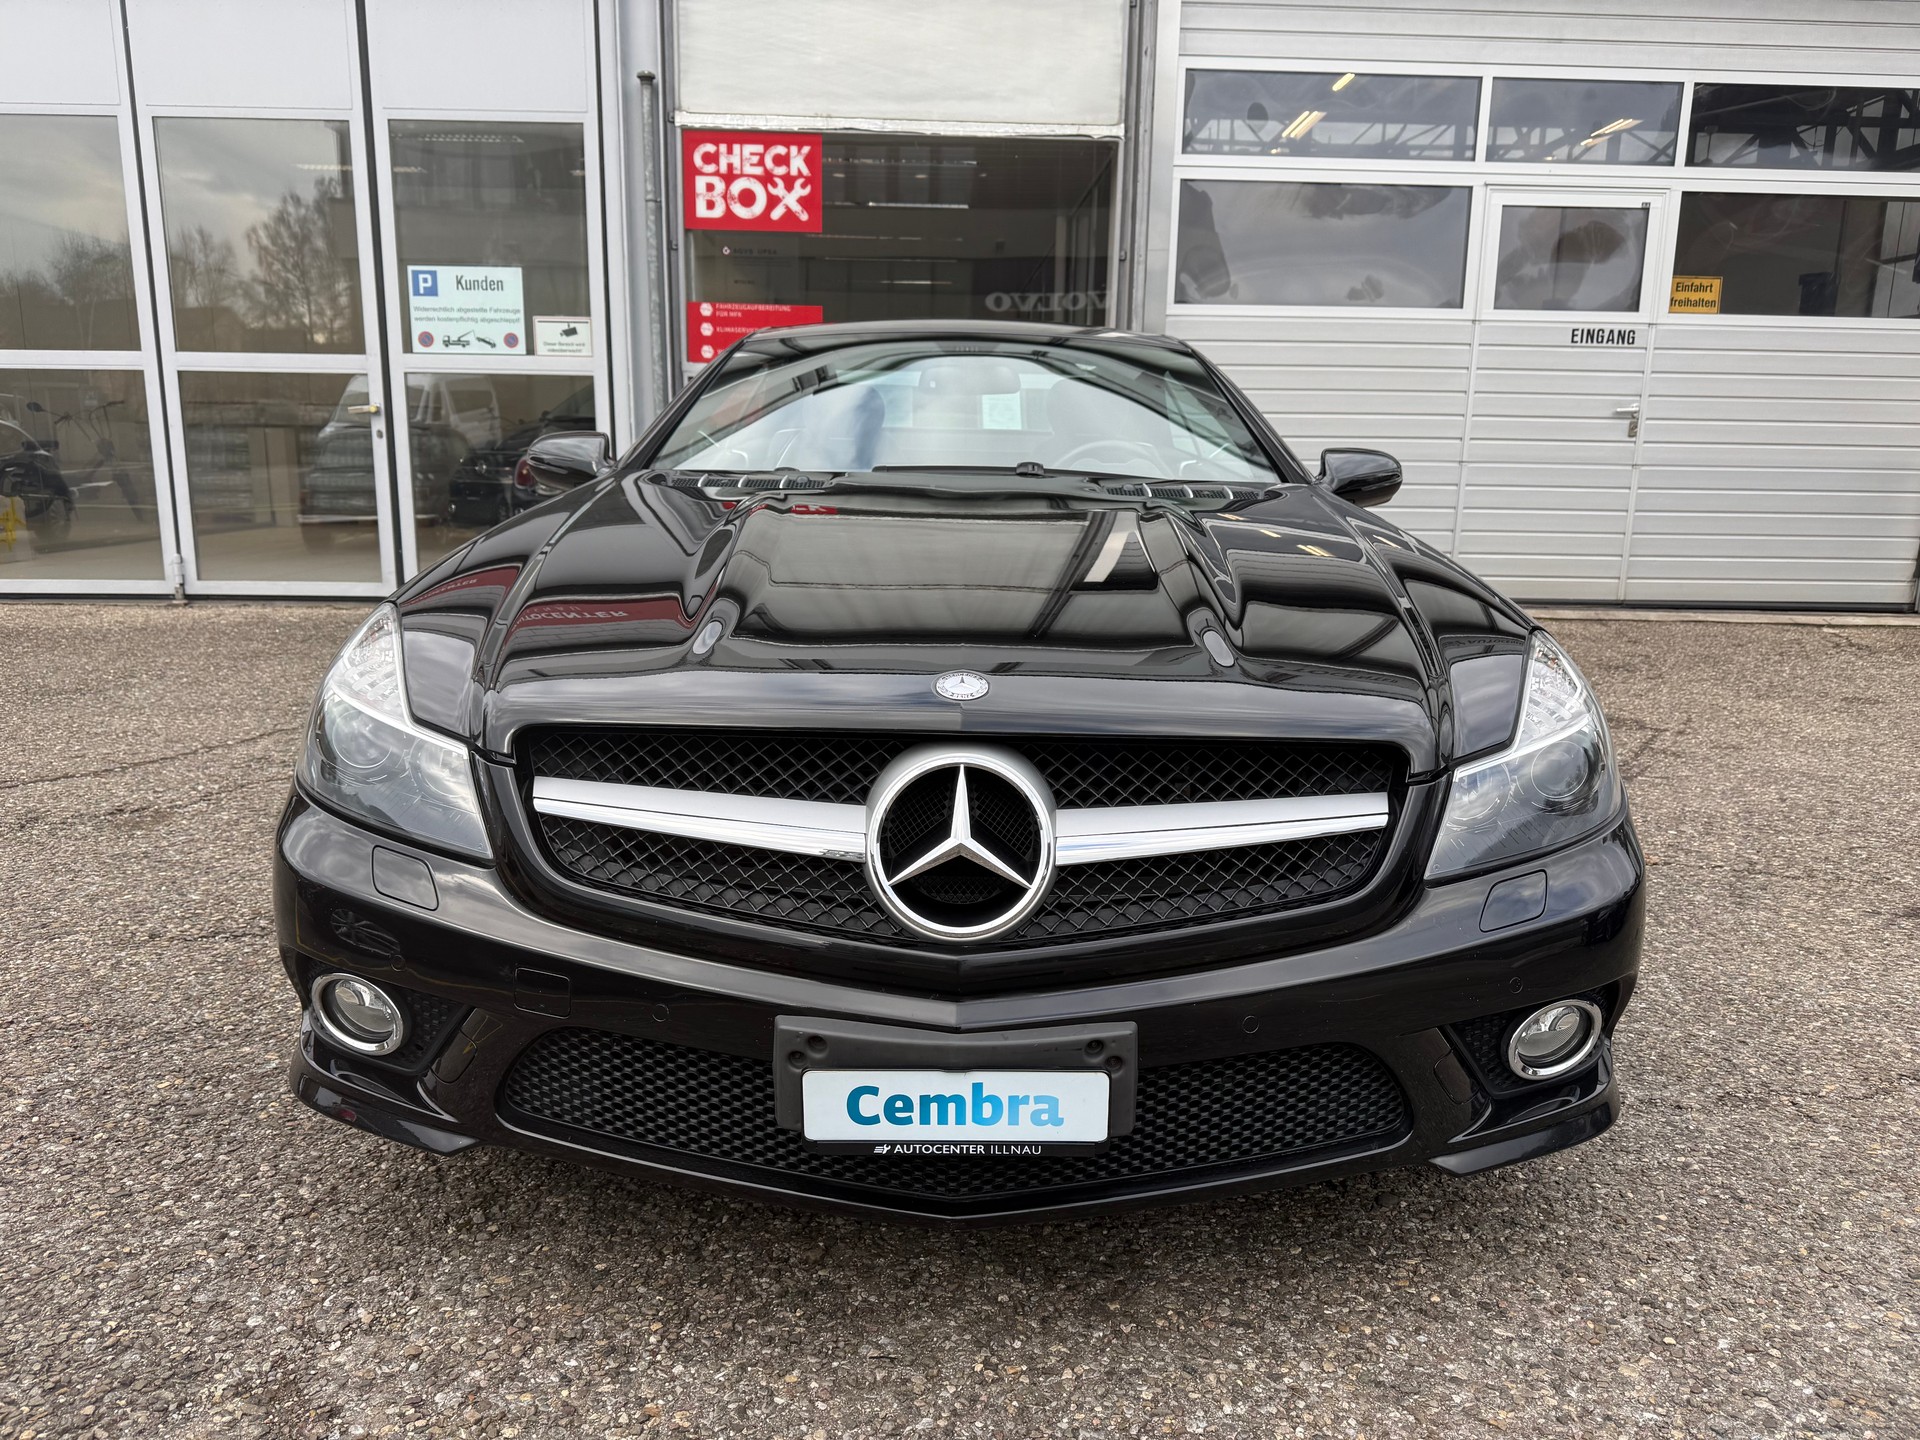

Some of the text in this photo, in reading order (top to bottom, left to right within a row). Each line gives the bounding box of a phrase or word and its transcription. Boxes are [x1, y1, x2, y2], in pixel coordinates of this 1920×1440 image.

[693, 143, 811, 176] CHECK
[695, 176, 811, 221] BOX
[418, 273, 504, 294] P Kunden
[1675, 281, 1713, 293] Einfahrt
[1670, 297, 1716, 308] freihalten
[1571, 328, 1636, 345] EINGANG
[847, 1082, 1064, 1127] Cembra
[893, 1144, 1042, 1155] AUTOCENTER ILLNAU
